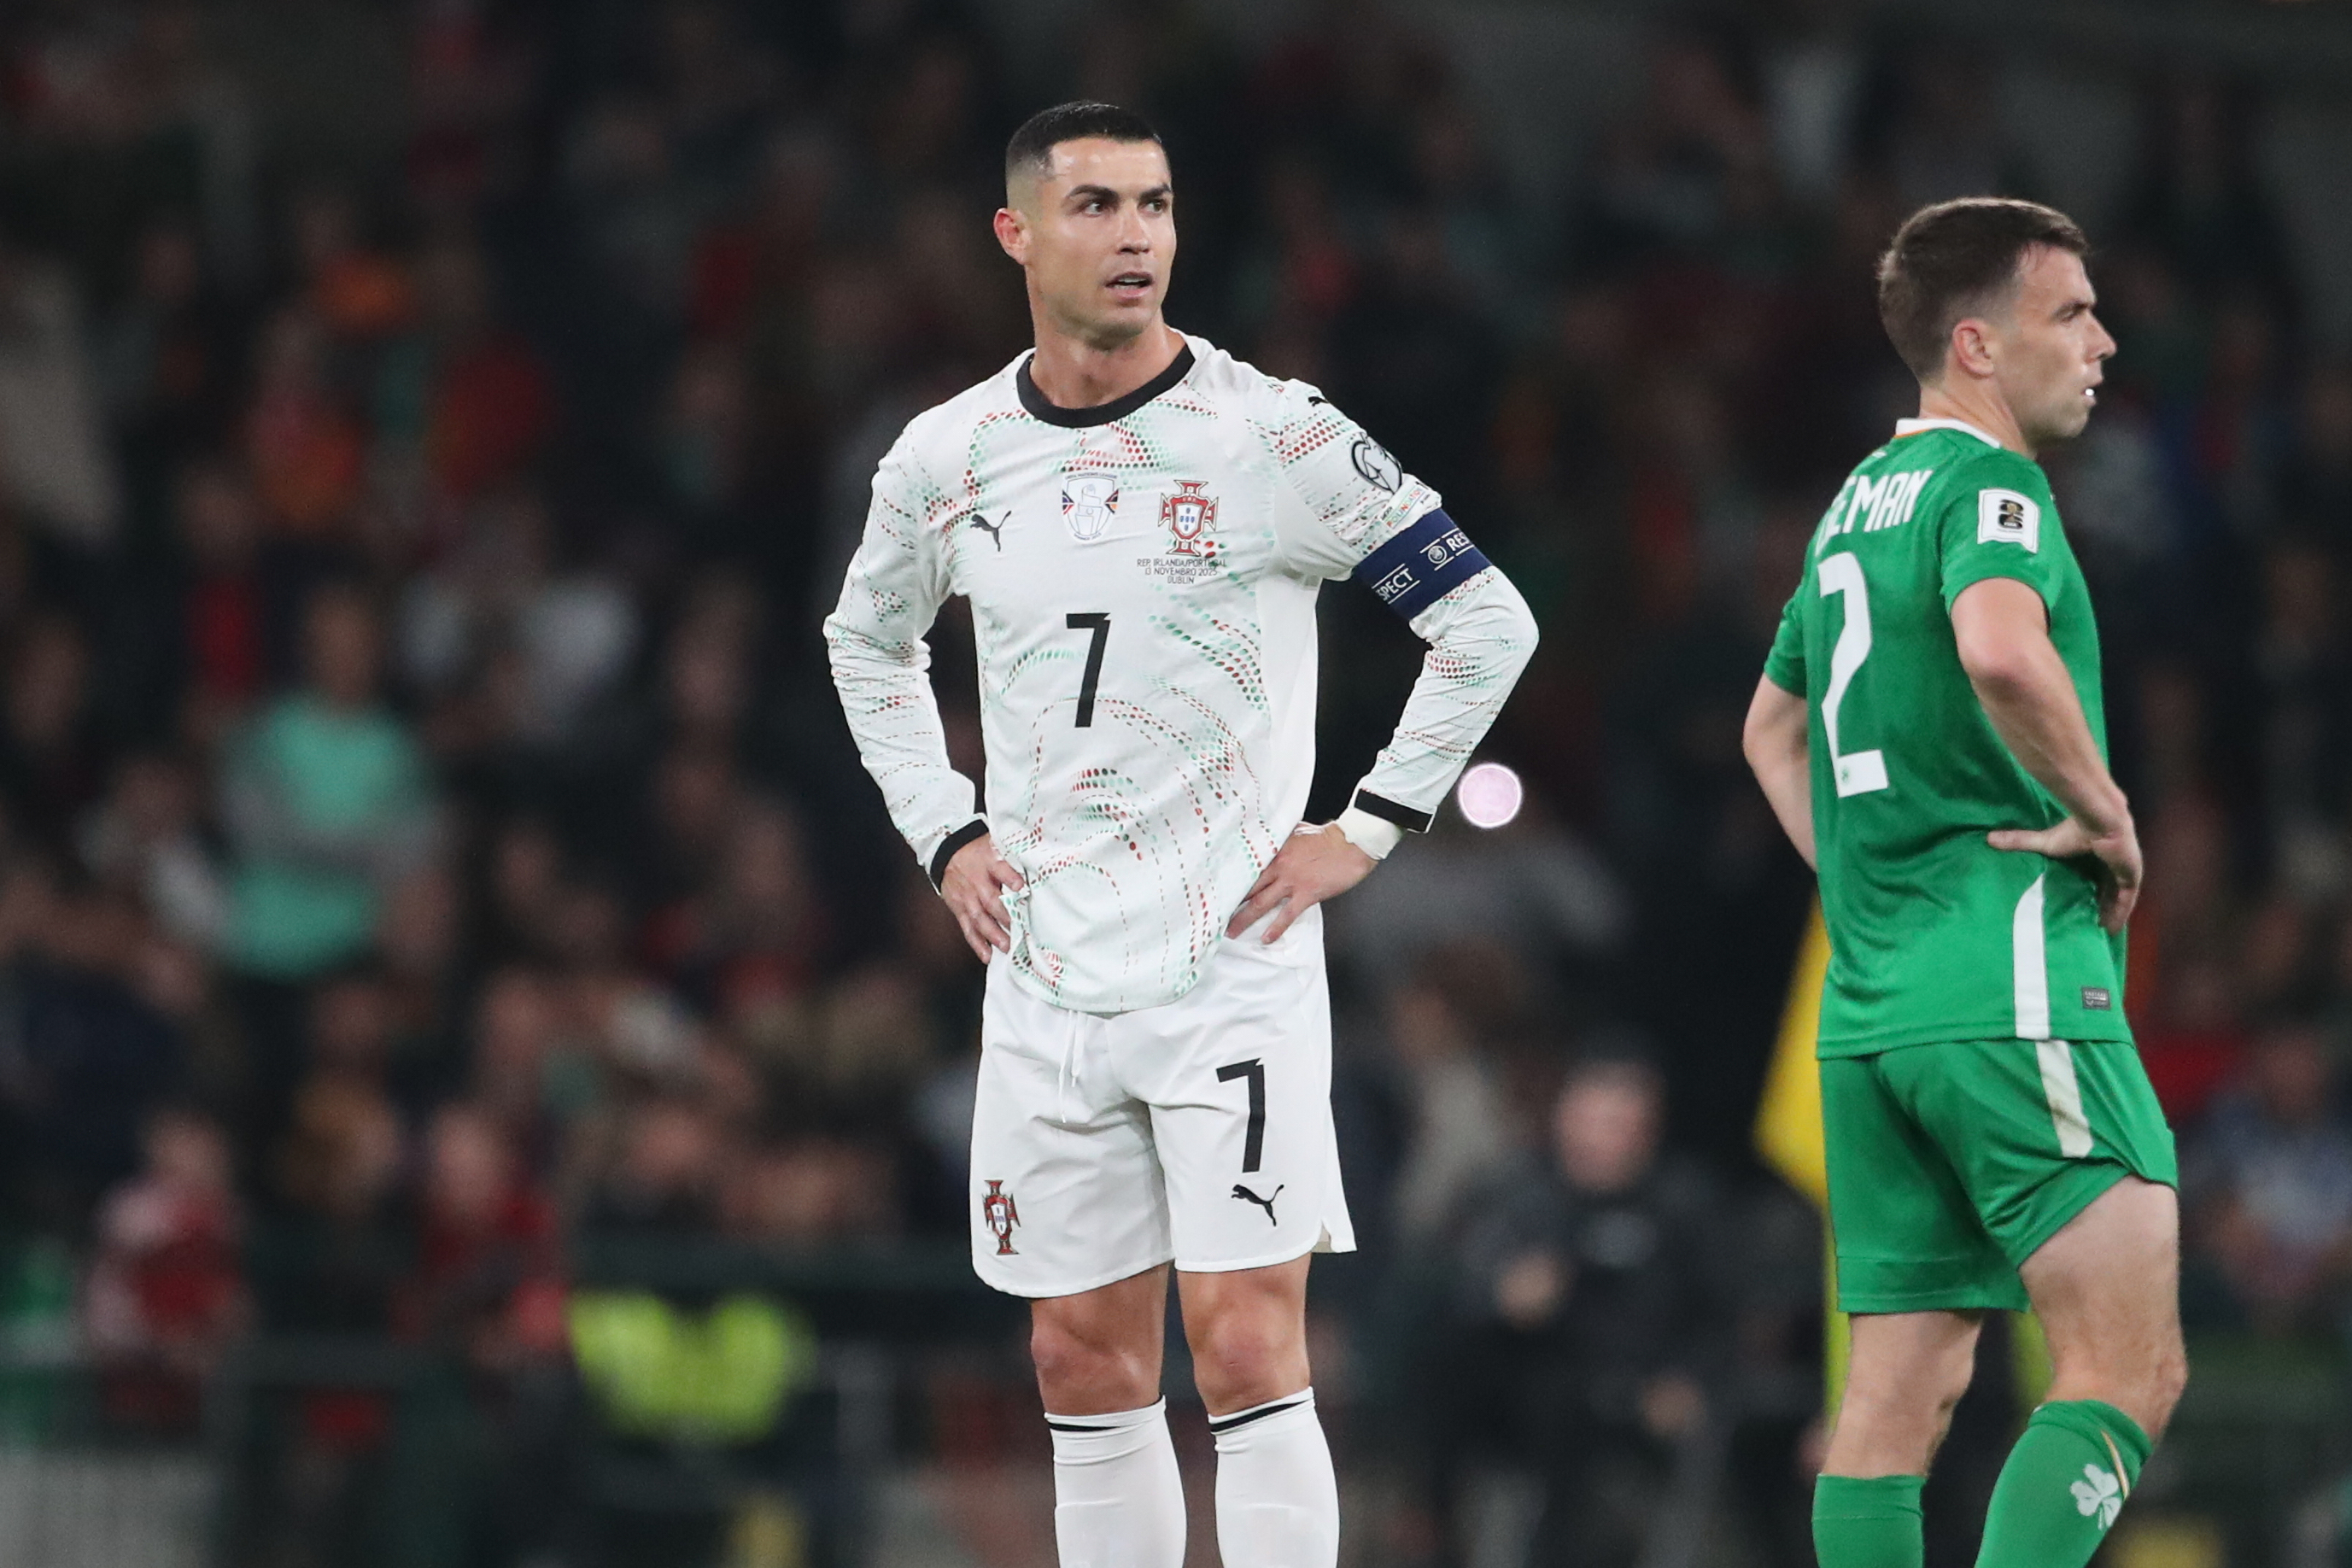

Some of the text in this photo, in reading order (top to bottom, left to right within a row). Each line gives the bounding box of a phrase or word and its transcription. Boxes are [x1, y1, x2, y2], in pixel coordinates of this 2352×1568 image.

[1154, 567, 1196, 576] NOVEMBRO
[1167, 576, 1195, 584] DUBLIN
[1066, 612, 1111, 728] 7
[1817, 552, 1889, 799] 2
[1216, 1057, 1266, 1173] 7
